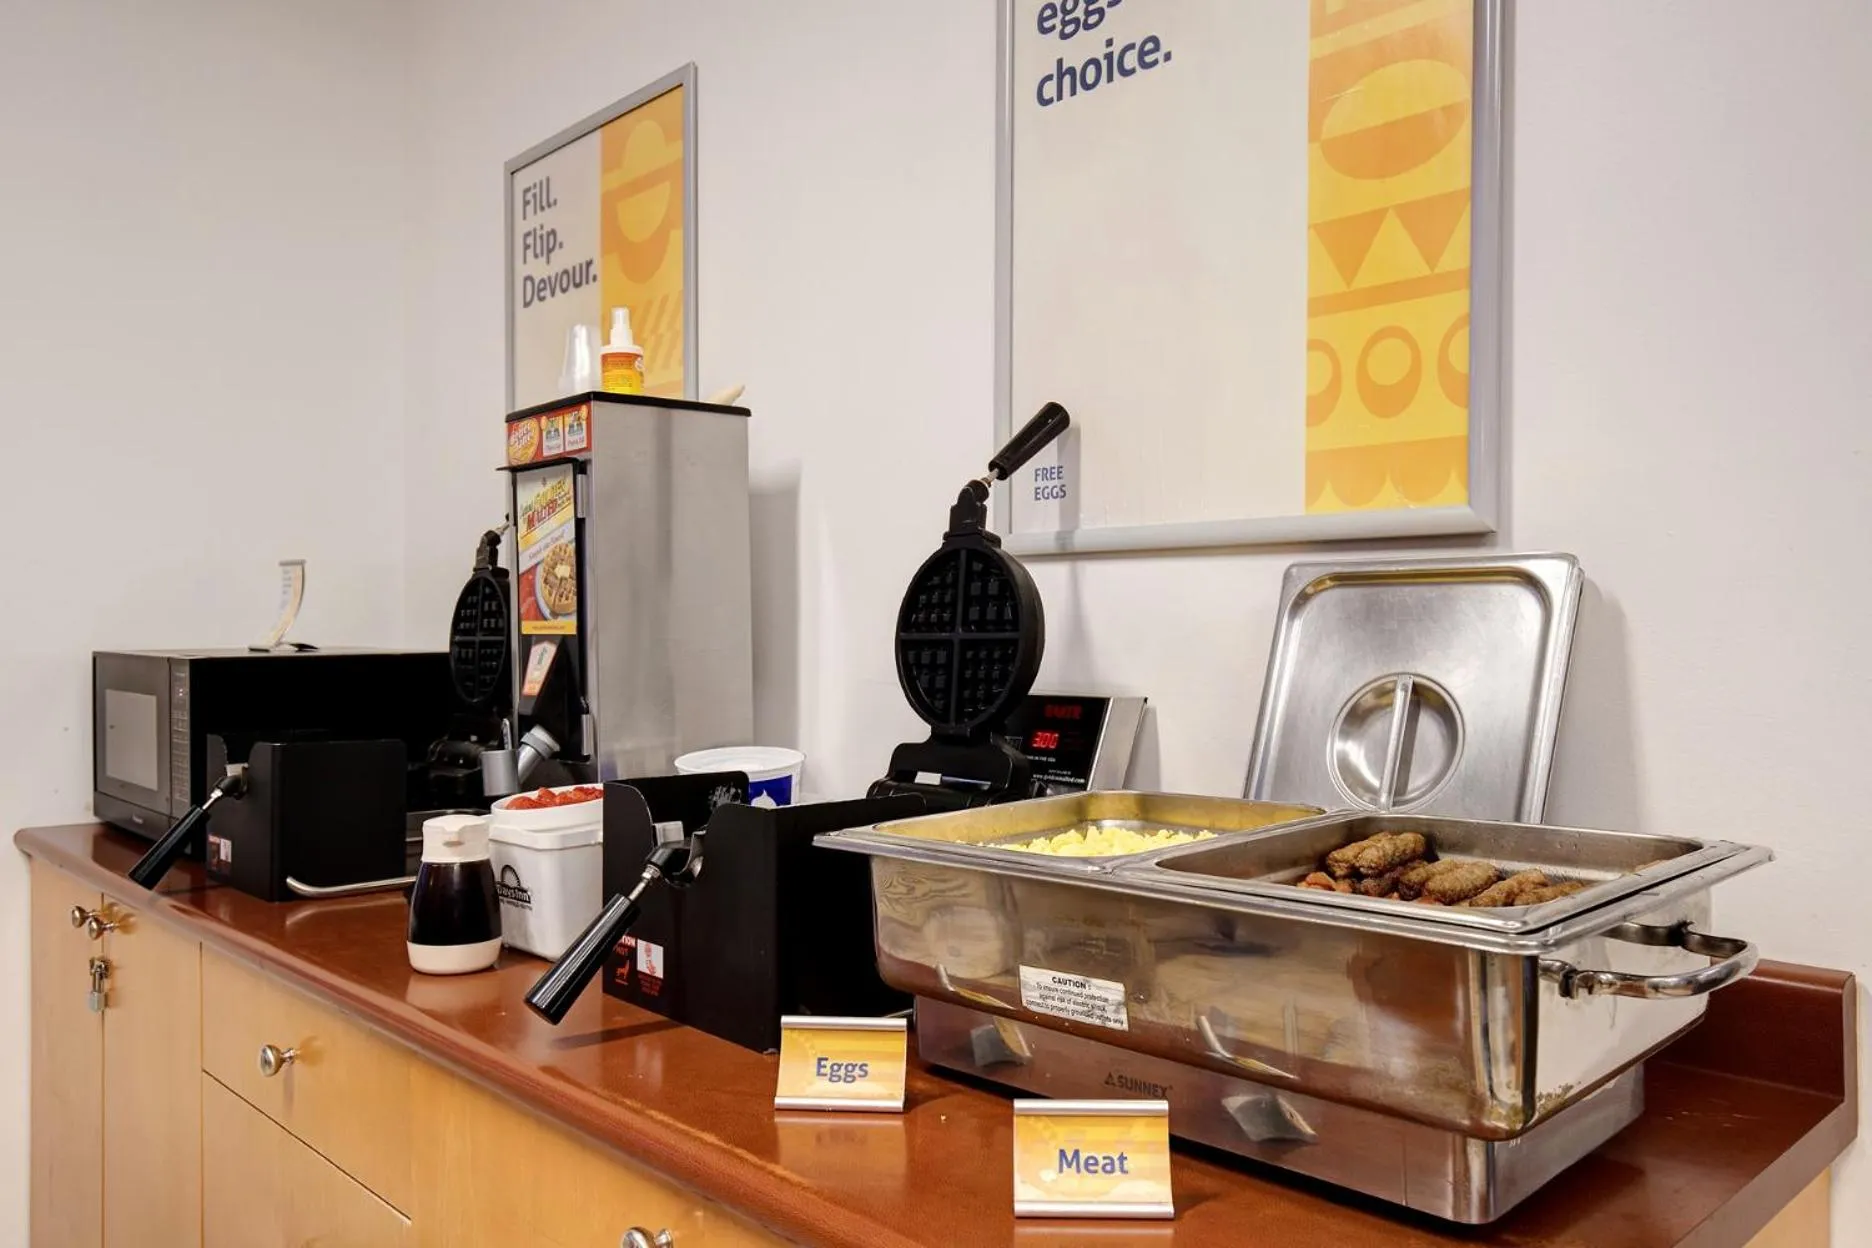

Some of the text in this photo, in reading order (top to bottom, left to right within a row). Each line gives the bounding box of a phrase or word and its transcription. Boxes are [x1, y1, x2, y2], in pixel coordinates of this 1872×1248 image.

[1037, 0, 1122, 40] egg
[1036, 34, 1172, 107] choice.
[522, 176, 558, 221] Fill.
[522, 223, 564, 266] Flip.
[522, 257, 598, 308] Devour.
[1034, 465, 1064, 482] FREE
[1034, 484, 1067, 501] EGGS
[1051, 976, 1087, 990] CAUTION
[816, 1056, 869, 1083] Eggs
[1117, 1074, 1168, 1099] SUNNEX
[1058, 1148, 1129, 1174] Meat
